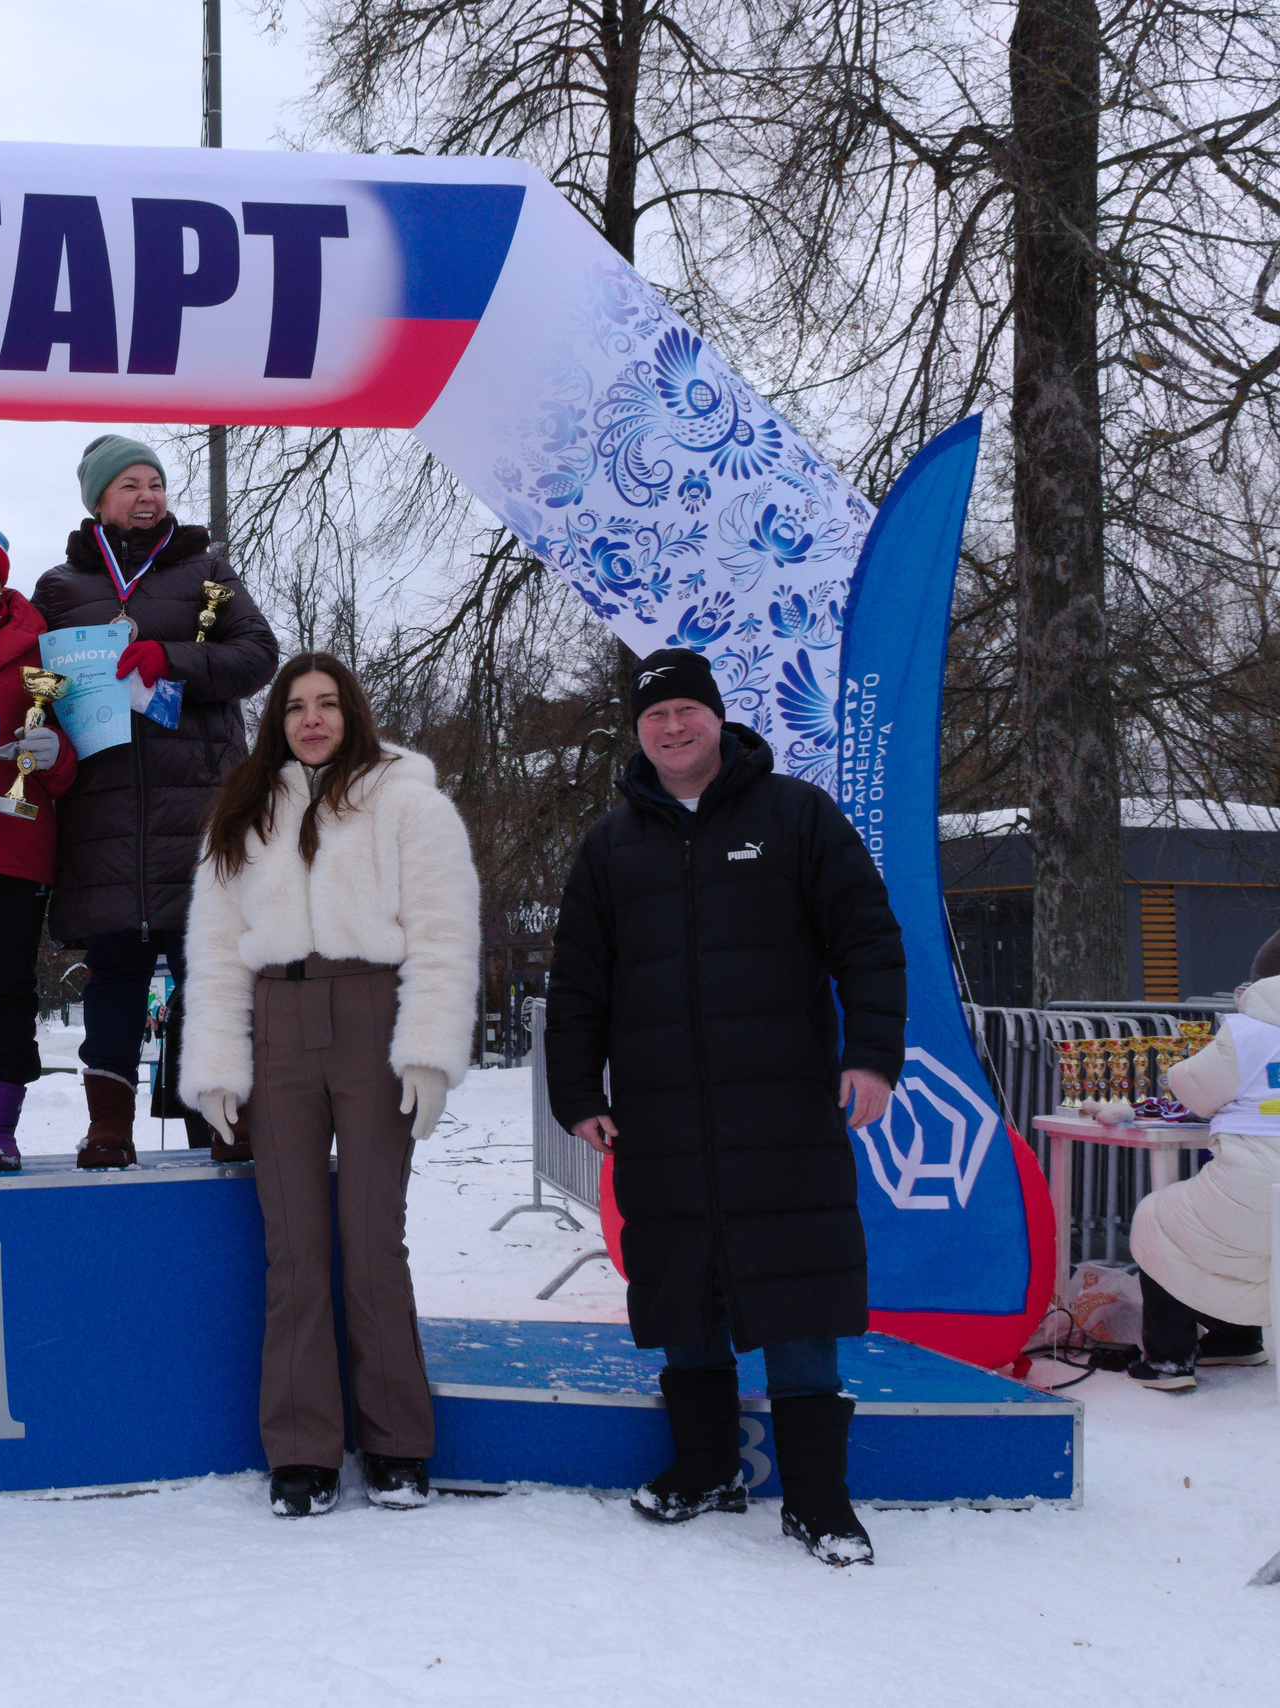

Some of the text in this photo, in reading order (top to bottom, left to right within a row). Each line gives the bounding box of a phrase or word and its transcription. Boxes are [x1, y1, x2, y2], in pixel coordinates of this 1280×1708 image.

[49, 649, 118, 670] ГРАМОТА
[842, 678, 860, 803] СПОРТУ
[854, 673, 880, 817] РАМЕНСКОГО
[870, 721, 894, 801] ОКРУГА
[727, 849, 758, 861] PUMA
